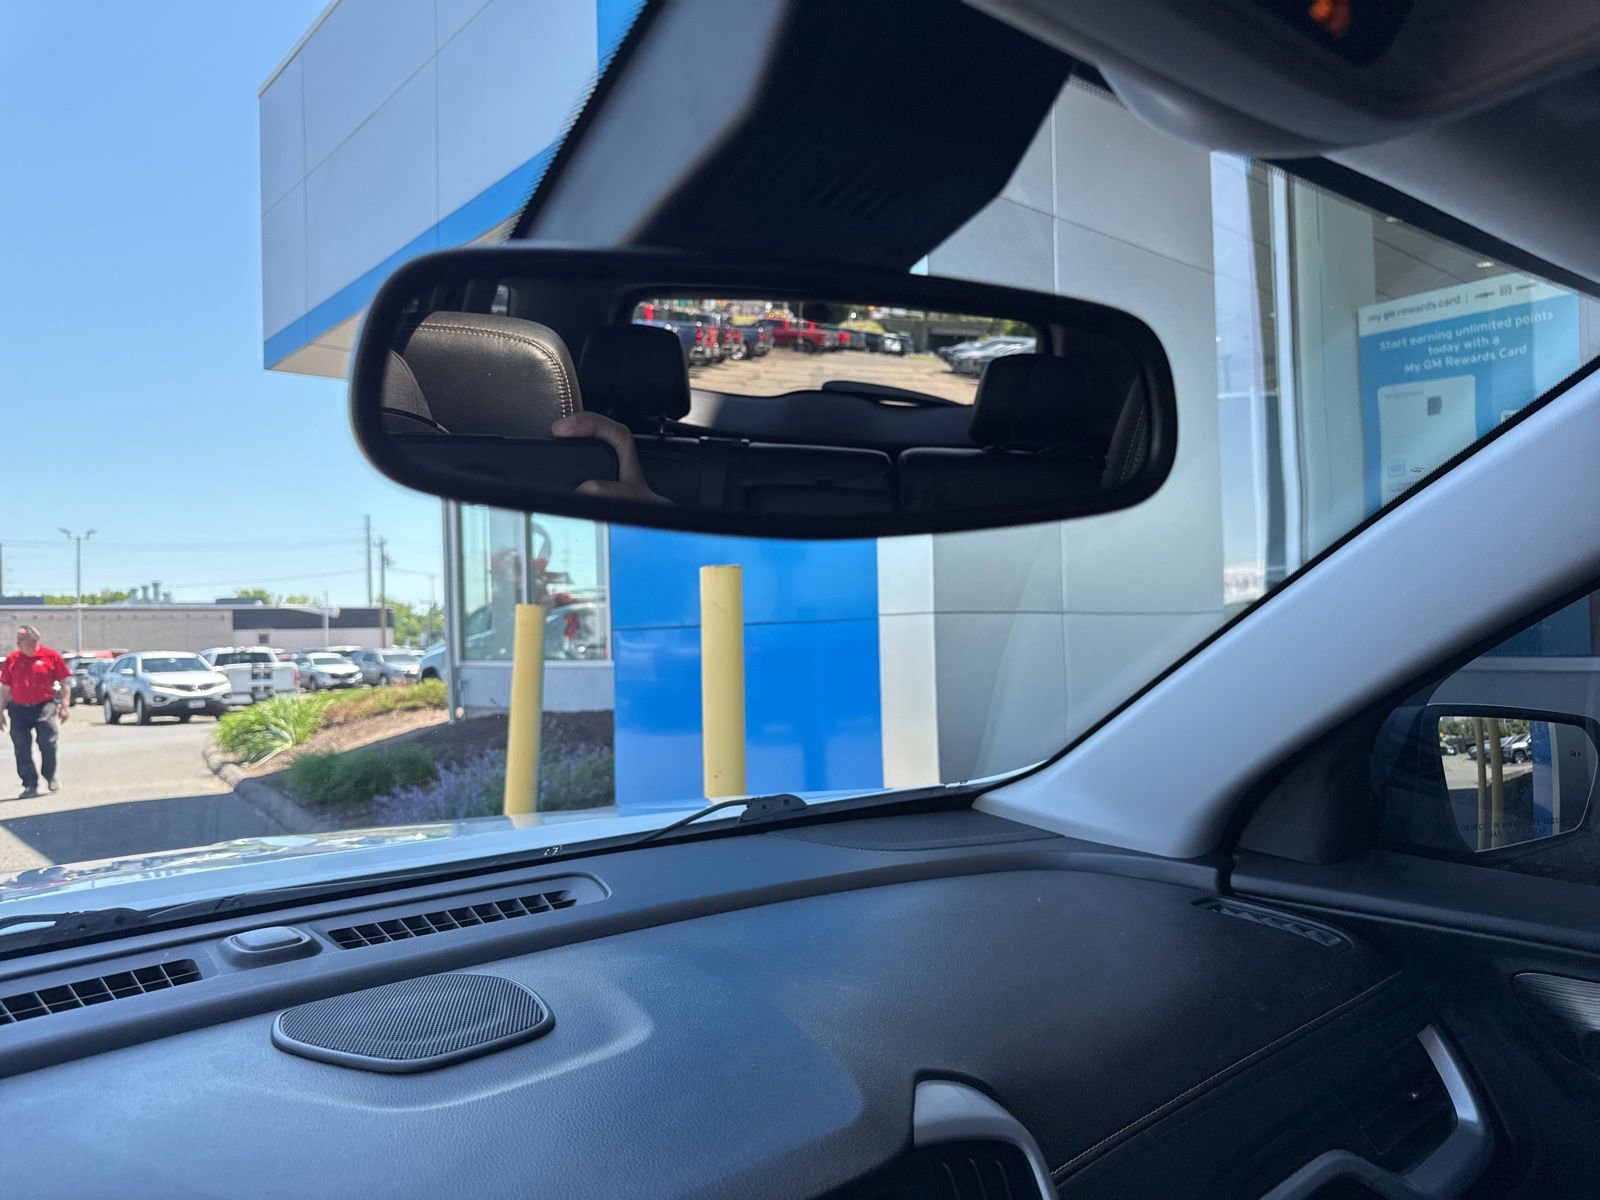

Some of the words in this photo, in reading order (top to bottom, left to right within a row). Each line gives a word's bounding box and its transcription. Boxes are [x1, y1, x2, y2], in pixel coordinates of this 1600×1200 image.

[1397, 299, 1437, 318] rewards
[1438, 294, 1461, 309] card
[1379, 337, 1408, 352] Start
[1409, 329, 1453, 346] earning
[1455, 316, 1513, 337] unlimited
[1515, 310, 1554, 329] points
[1404, 361, 1421, 375] My
[1423, 358, 1443, 371] GM
[1445, 351, 1496, 368] Rewards
[1499, 344, 1528, 359] Card
[1428, 340, 1460, 356] today
[1464, 336, 1490, 350] with
[1492, 336, 1500, 346] a
